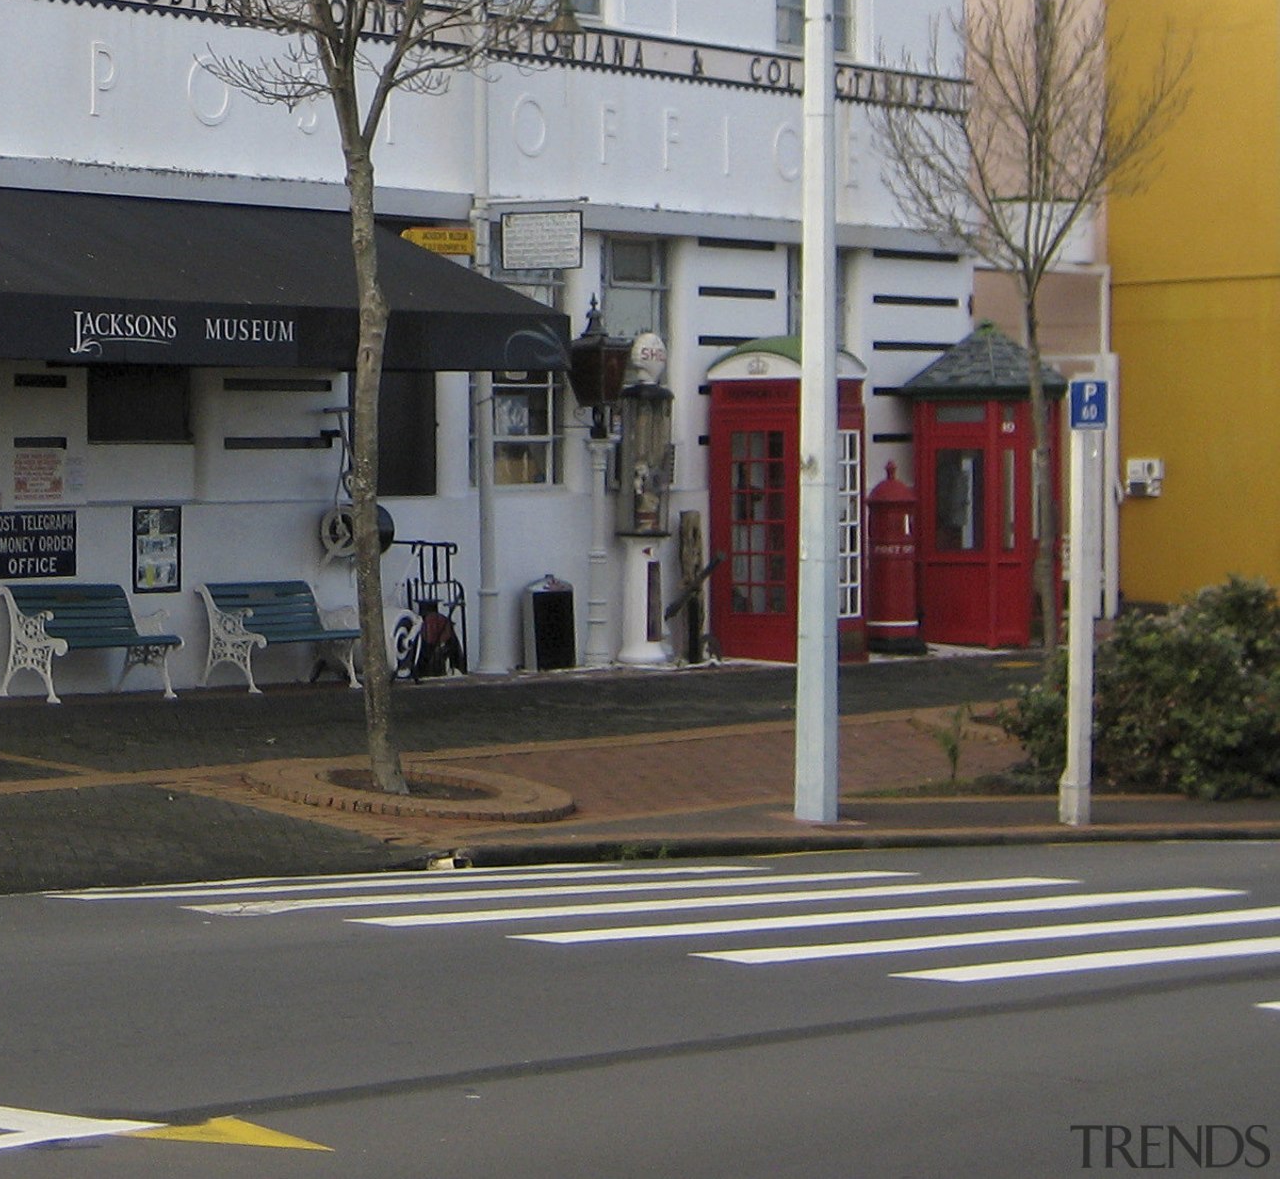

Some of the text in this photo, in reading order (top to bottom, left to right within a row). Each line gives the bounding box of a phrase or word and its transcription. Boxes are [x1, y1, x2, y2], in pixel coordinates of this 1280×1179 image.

[691, 49, 705, 76] &
[70, 310, 295, 355] JACKSONS MUSEUM
[1084, 383, 1098, 403] P
[1081, 404, 1098, 420] 60
[21, 513, 74, 531] TELEGRAPH
[0, 536, 35, 553] MONEY
[38, 535, 74, 552] ORDER
[8, 556, 58, 574] OFFICE
